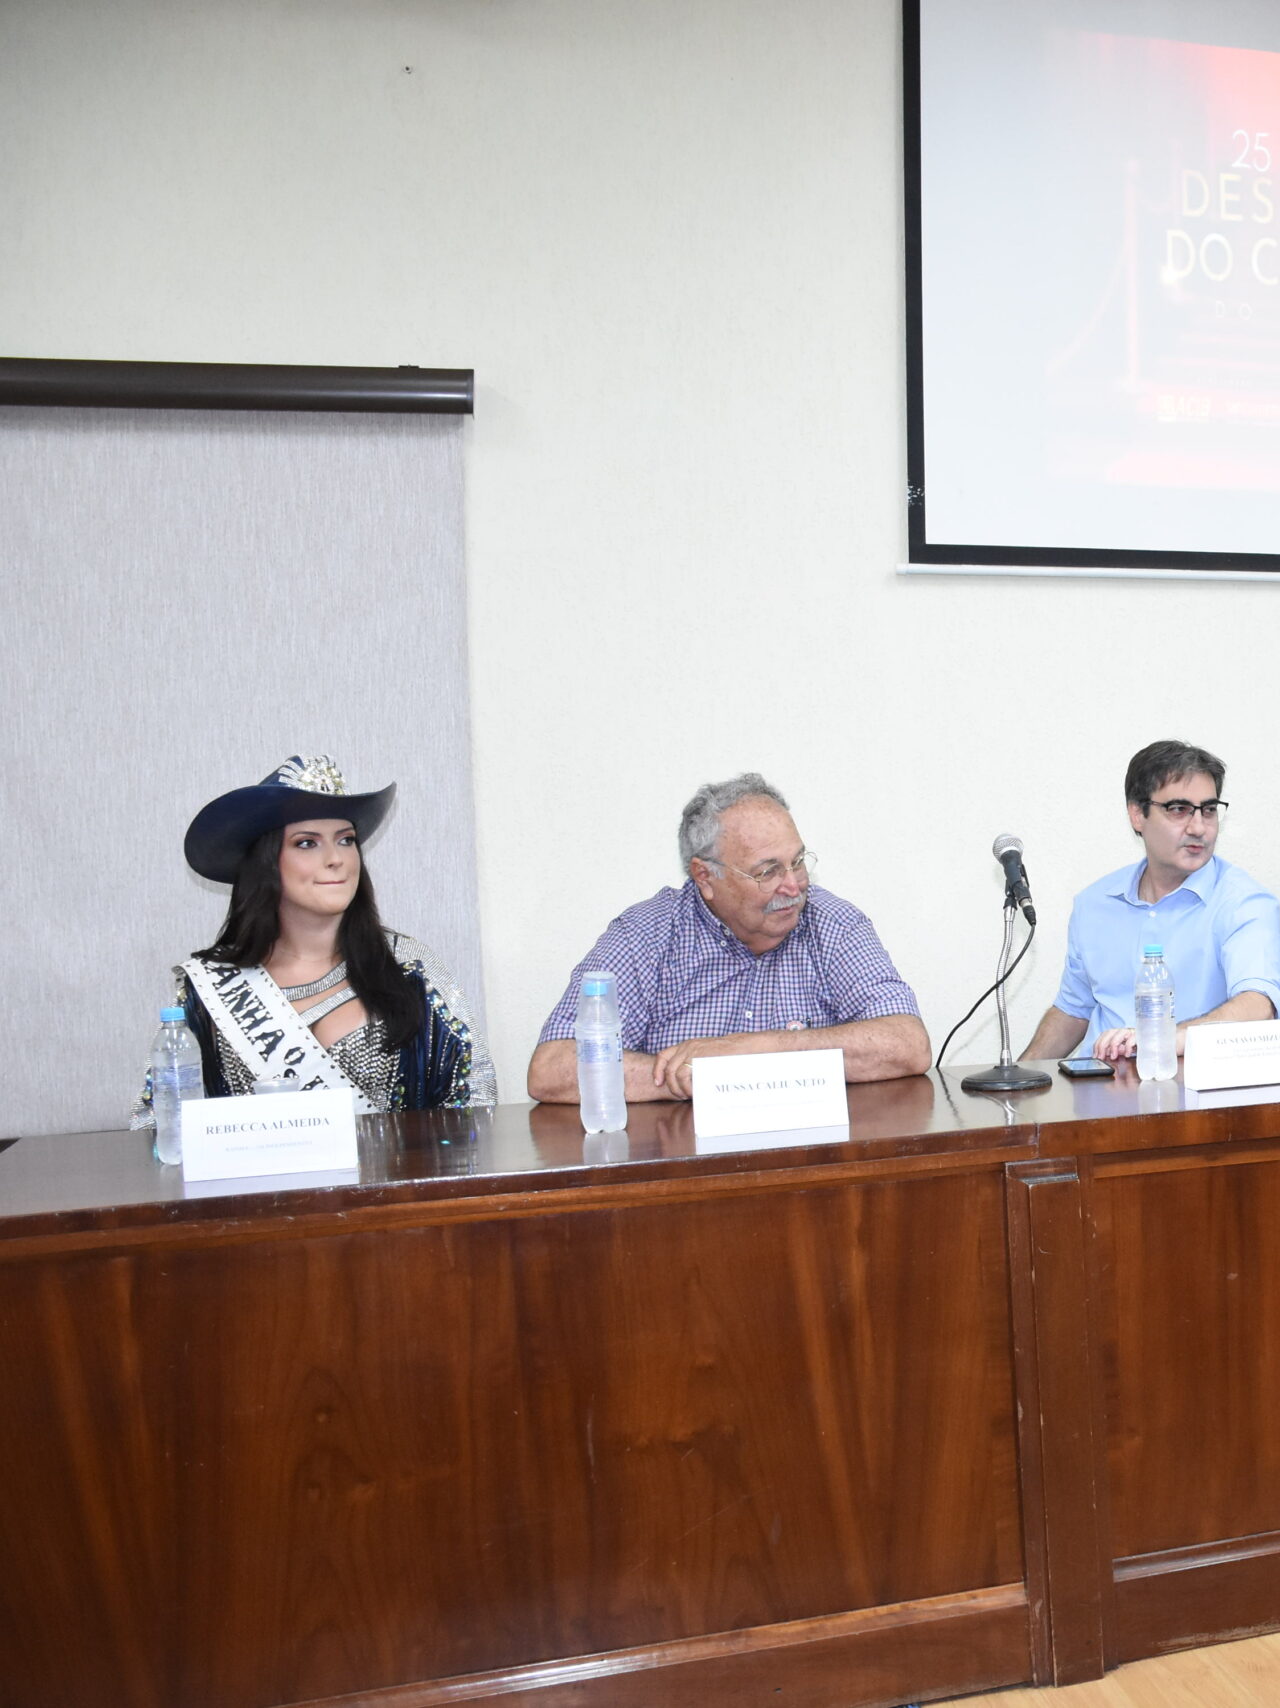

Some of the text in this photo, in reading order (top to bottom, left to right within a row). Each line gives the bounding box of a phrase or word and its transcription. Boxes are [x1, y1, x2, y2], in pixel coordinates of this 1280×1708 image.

[1231, 129, 1272, 173] 25
[1164, 228, 1234, 282] DO
[201, 960, 285, 1062] AINHA
[714, 1083, 754, 1094] MUSSA
[794, 1077, 827, 1089] NETO
[205, 1116, 330, 1135] REBECCA ALMEIDA
